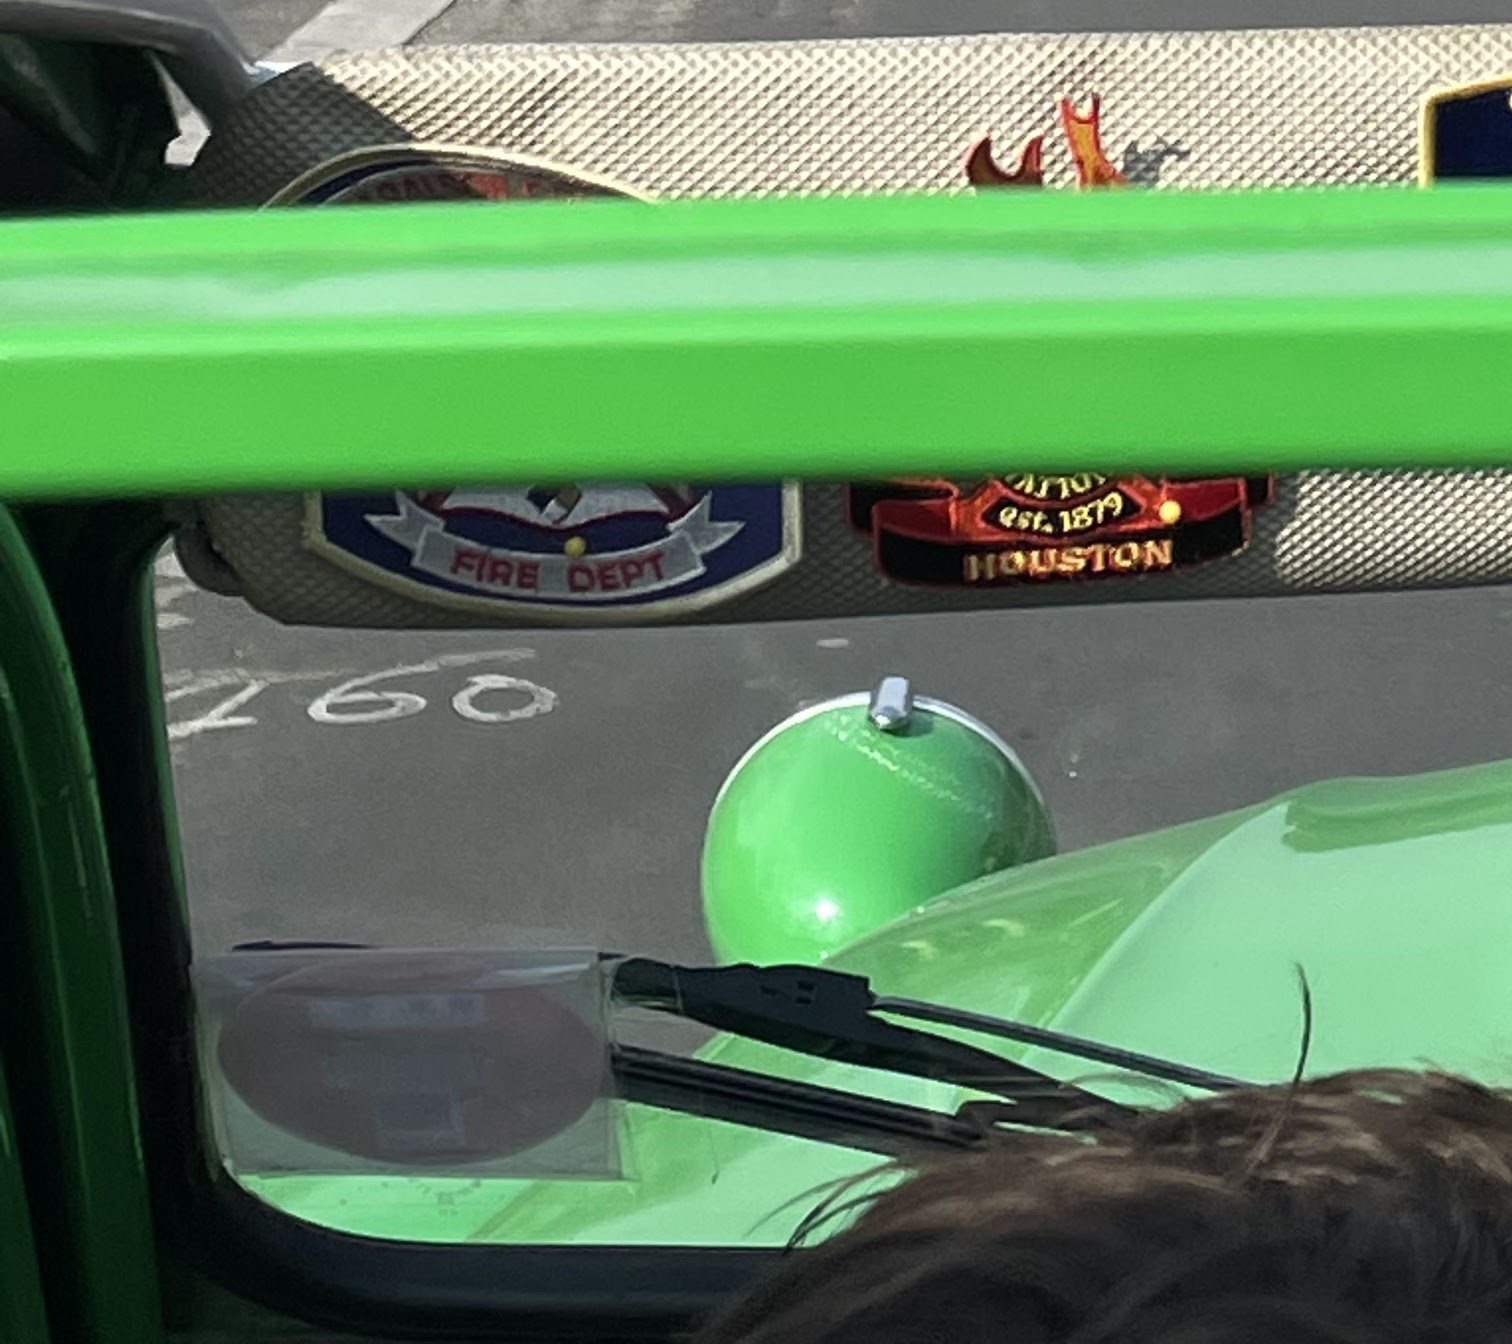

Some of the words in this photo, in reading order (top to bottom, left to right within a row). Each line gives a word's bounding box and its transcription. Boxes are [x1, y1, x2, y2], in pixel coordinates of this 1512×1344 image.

[1059, 490, 1124, 533] 1879
[449, 546, 541, 591] FIRE
[566, 549, 666, 594] DEPT
[963, 538, 1175, 582] HOUSTON
